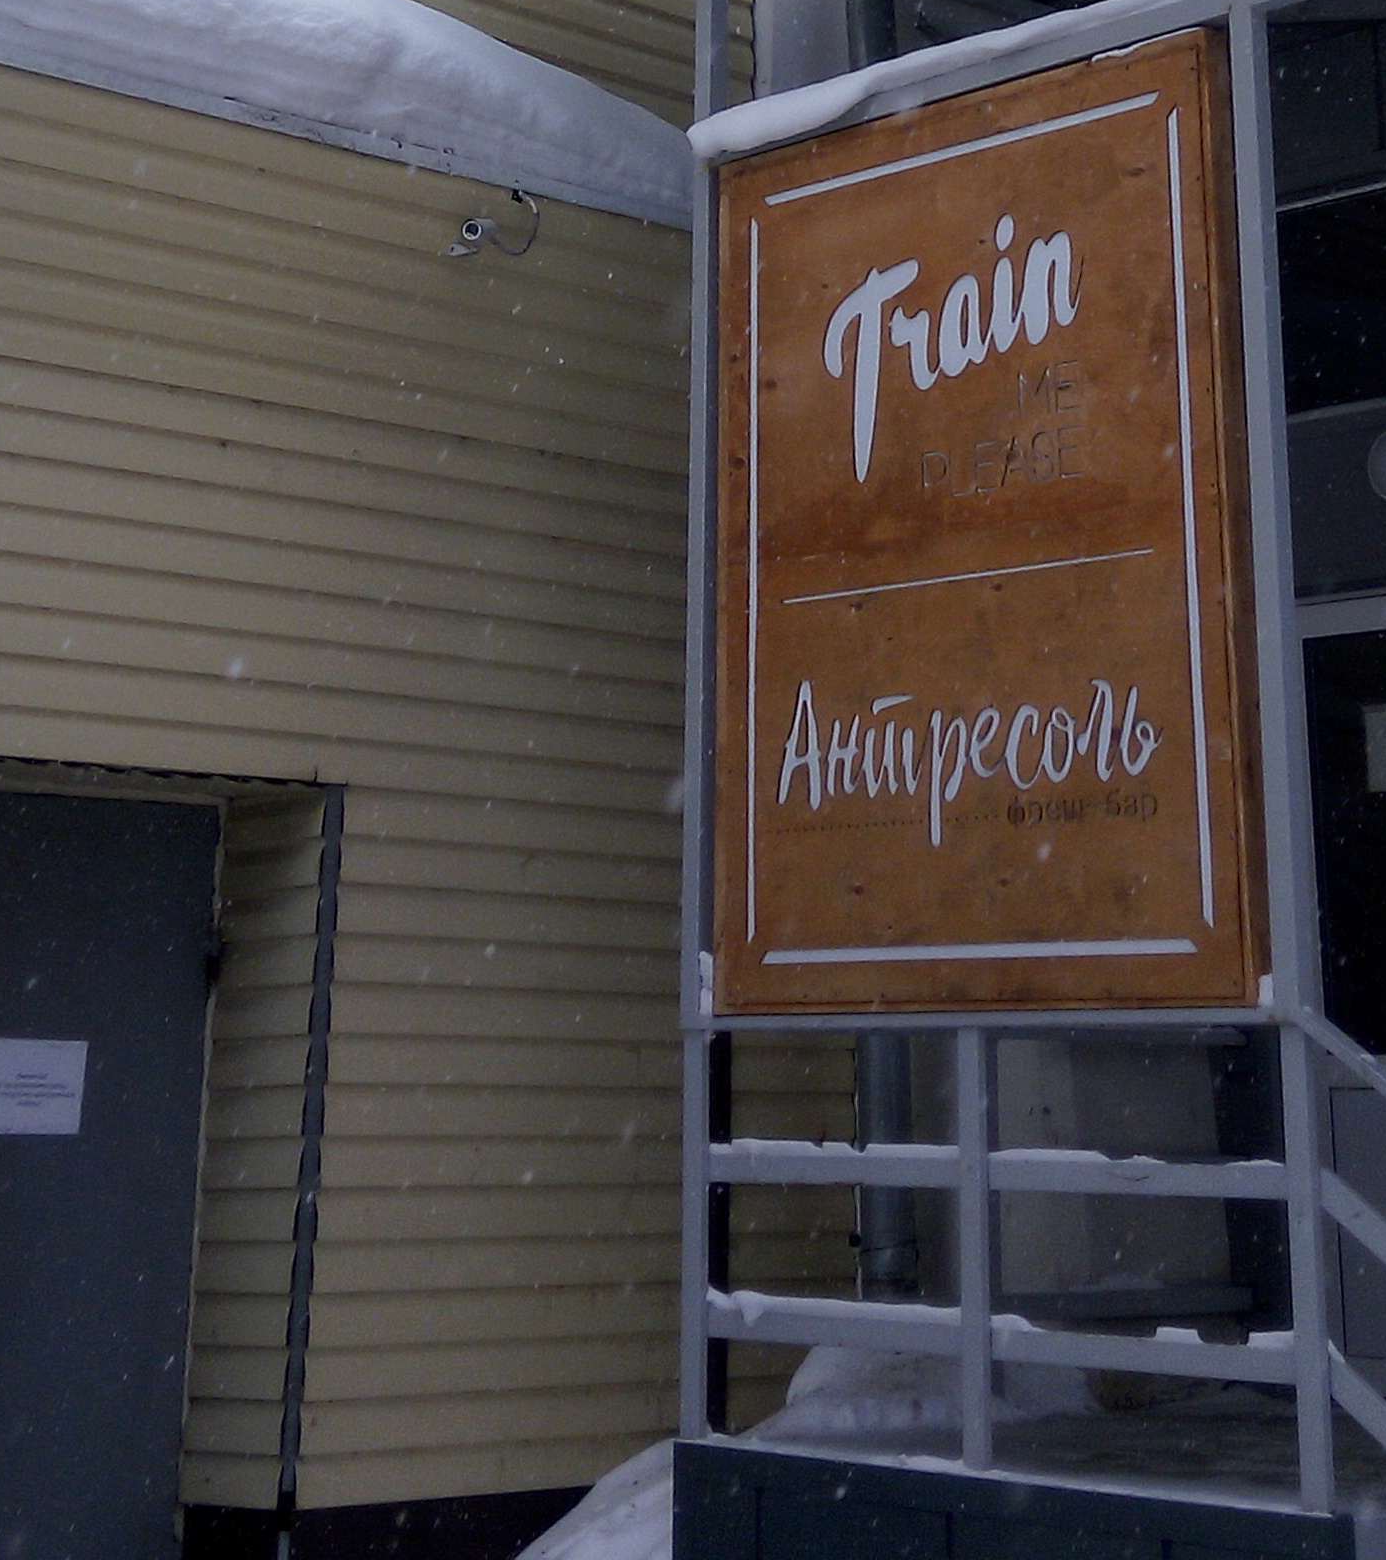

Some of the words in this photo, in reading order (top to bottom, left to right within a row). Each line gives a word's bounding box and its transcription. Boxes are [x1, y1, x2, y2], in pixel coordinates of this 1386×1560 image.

[823, 213, 1082, 484] Train
[1017, 360, 1080, 415] ME
[921, 426, 1084, 496] PLEASE
[776, 679, 1162, 847] Антресоль
